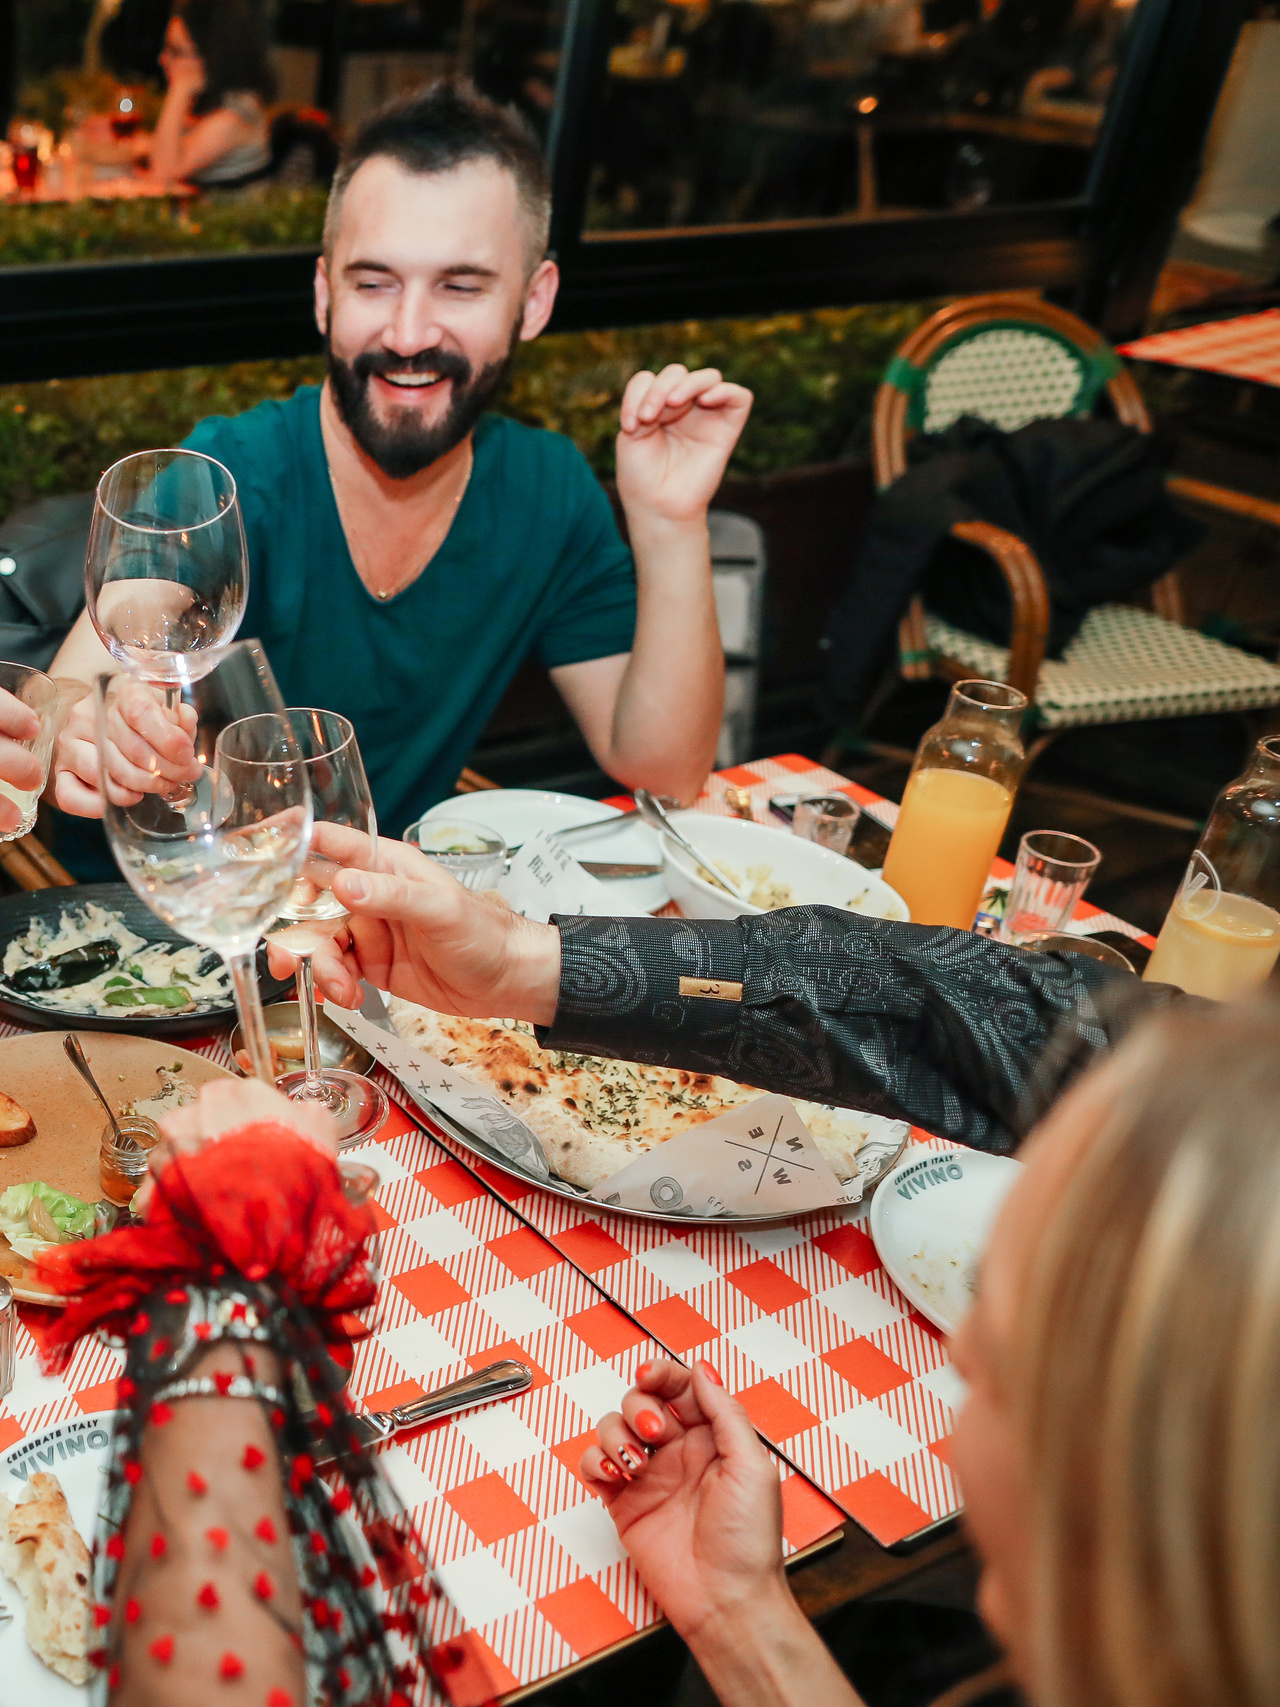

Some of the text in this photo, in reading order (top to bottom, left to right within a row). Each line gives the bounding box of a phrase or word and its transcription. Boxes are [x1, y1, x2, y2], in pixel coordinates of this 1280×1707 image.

[894, 1161, 928, 1185] CELEBRATE
[931, 1155, 954, 1165] ITALY
[897, 1163, 963, 1200] VIVINO
[7, 1419, 99, 1464] CELEBRATE ITALY
[10, 1429, 109, 1482] VIVINO
